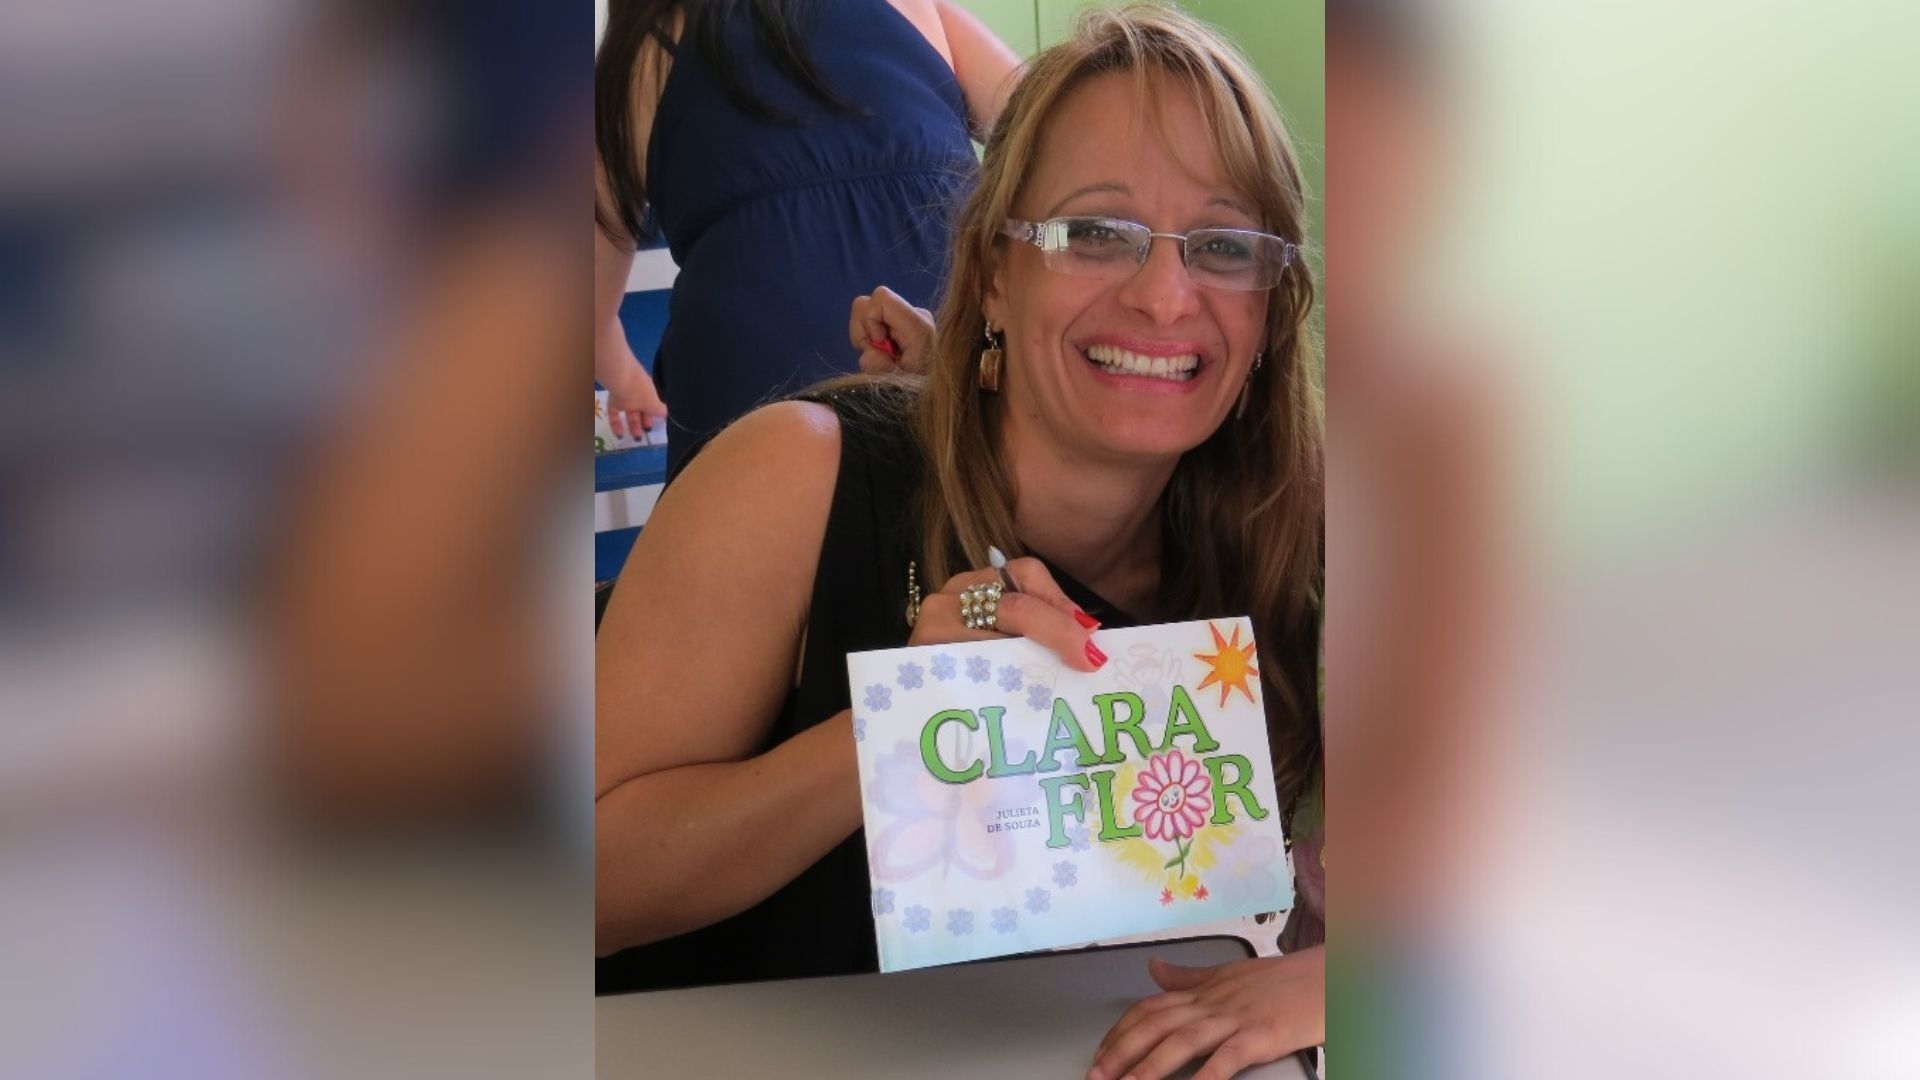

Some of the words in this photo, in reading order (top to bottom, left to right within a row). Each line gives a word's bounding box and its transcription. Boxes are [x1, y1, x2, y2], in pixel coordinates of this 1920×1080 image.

[919, 685, 1220, 784] CLARA
[987, 823, 1002, 833] DE
[1004, 819, 1041, 831] SOUZA
[996, 806, 1040, 820] JULIETA
[1039, 751, 1269, 848] FLOR
